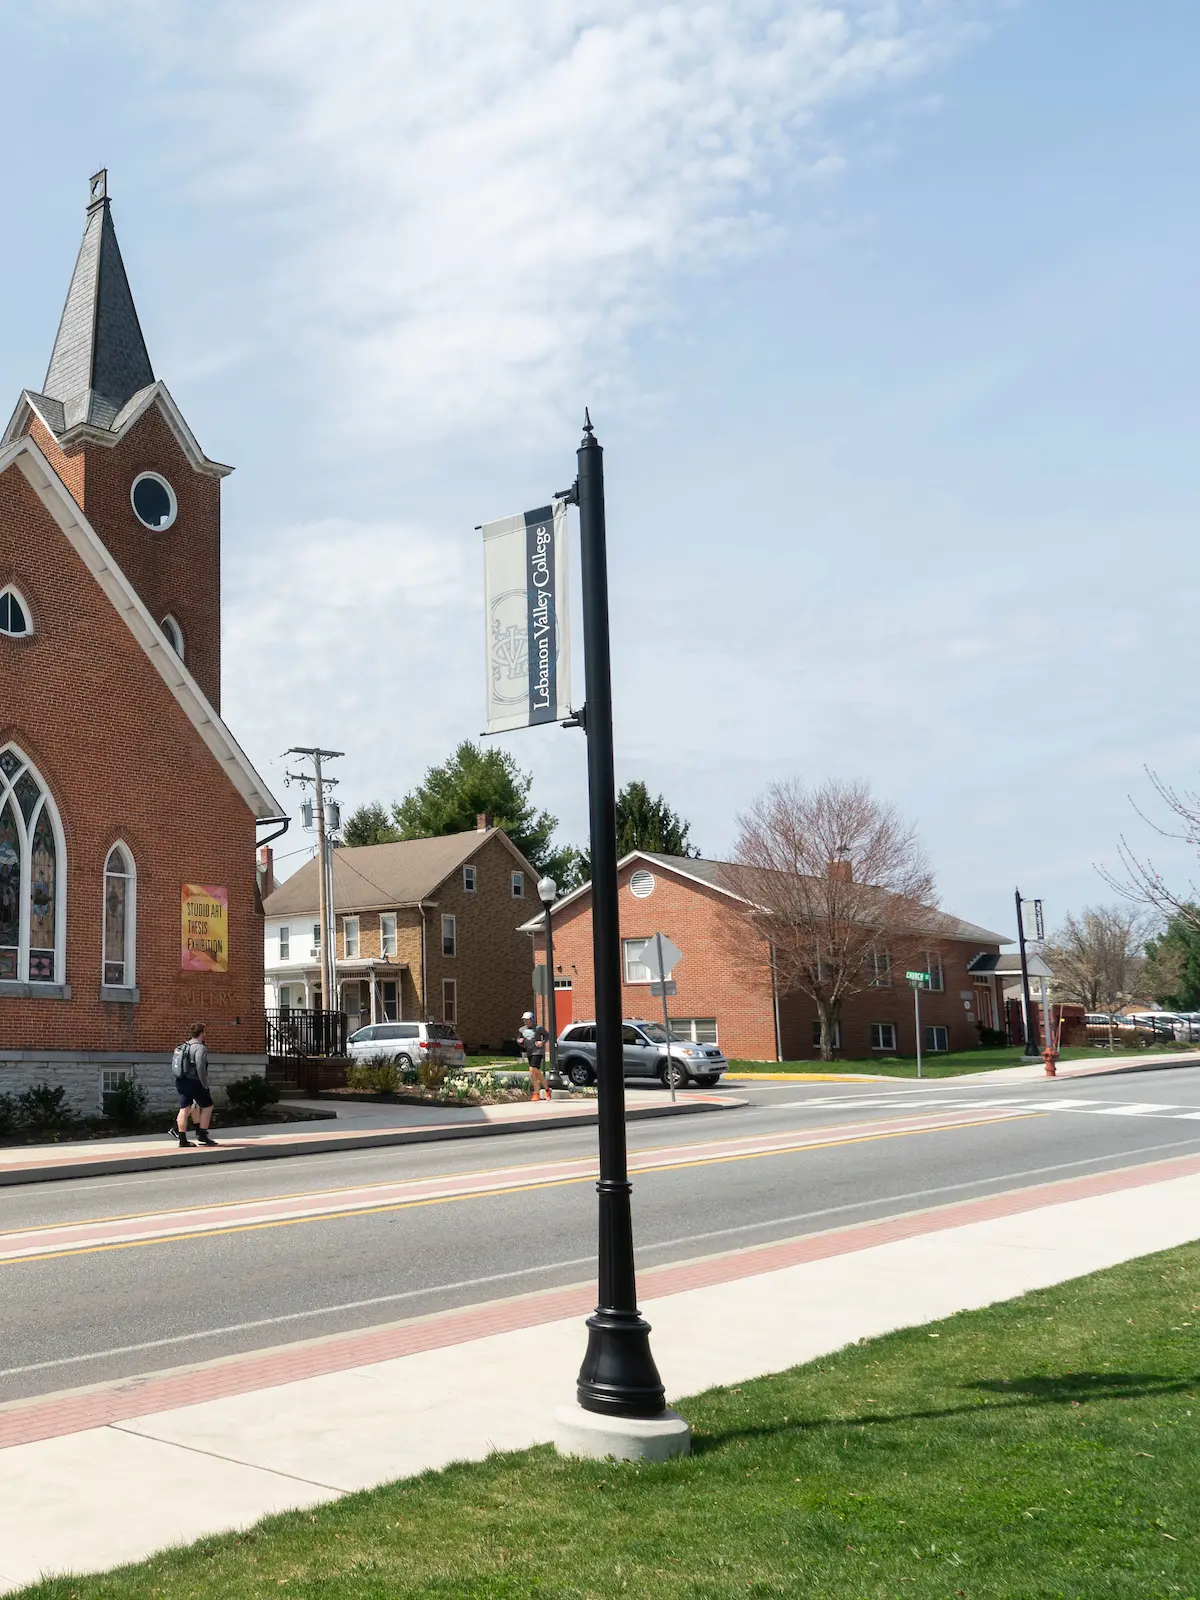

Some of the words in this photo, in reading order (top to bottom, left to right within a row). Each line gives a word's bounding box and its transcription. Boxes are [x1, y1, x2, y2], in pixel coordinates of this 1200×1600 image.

[531, 526, 551, 588] College
[533, 590, 552, 640] Valley
[533, 637, 550, 711] Lebanon
[187, 902, 210, 918] STUDIO
[211, 904, 222, 919] ART
[188, 920, 208, 935] THESIS
[187, 938, 223, 954] EXHIBITION
